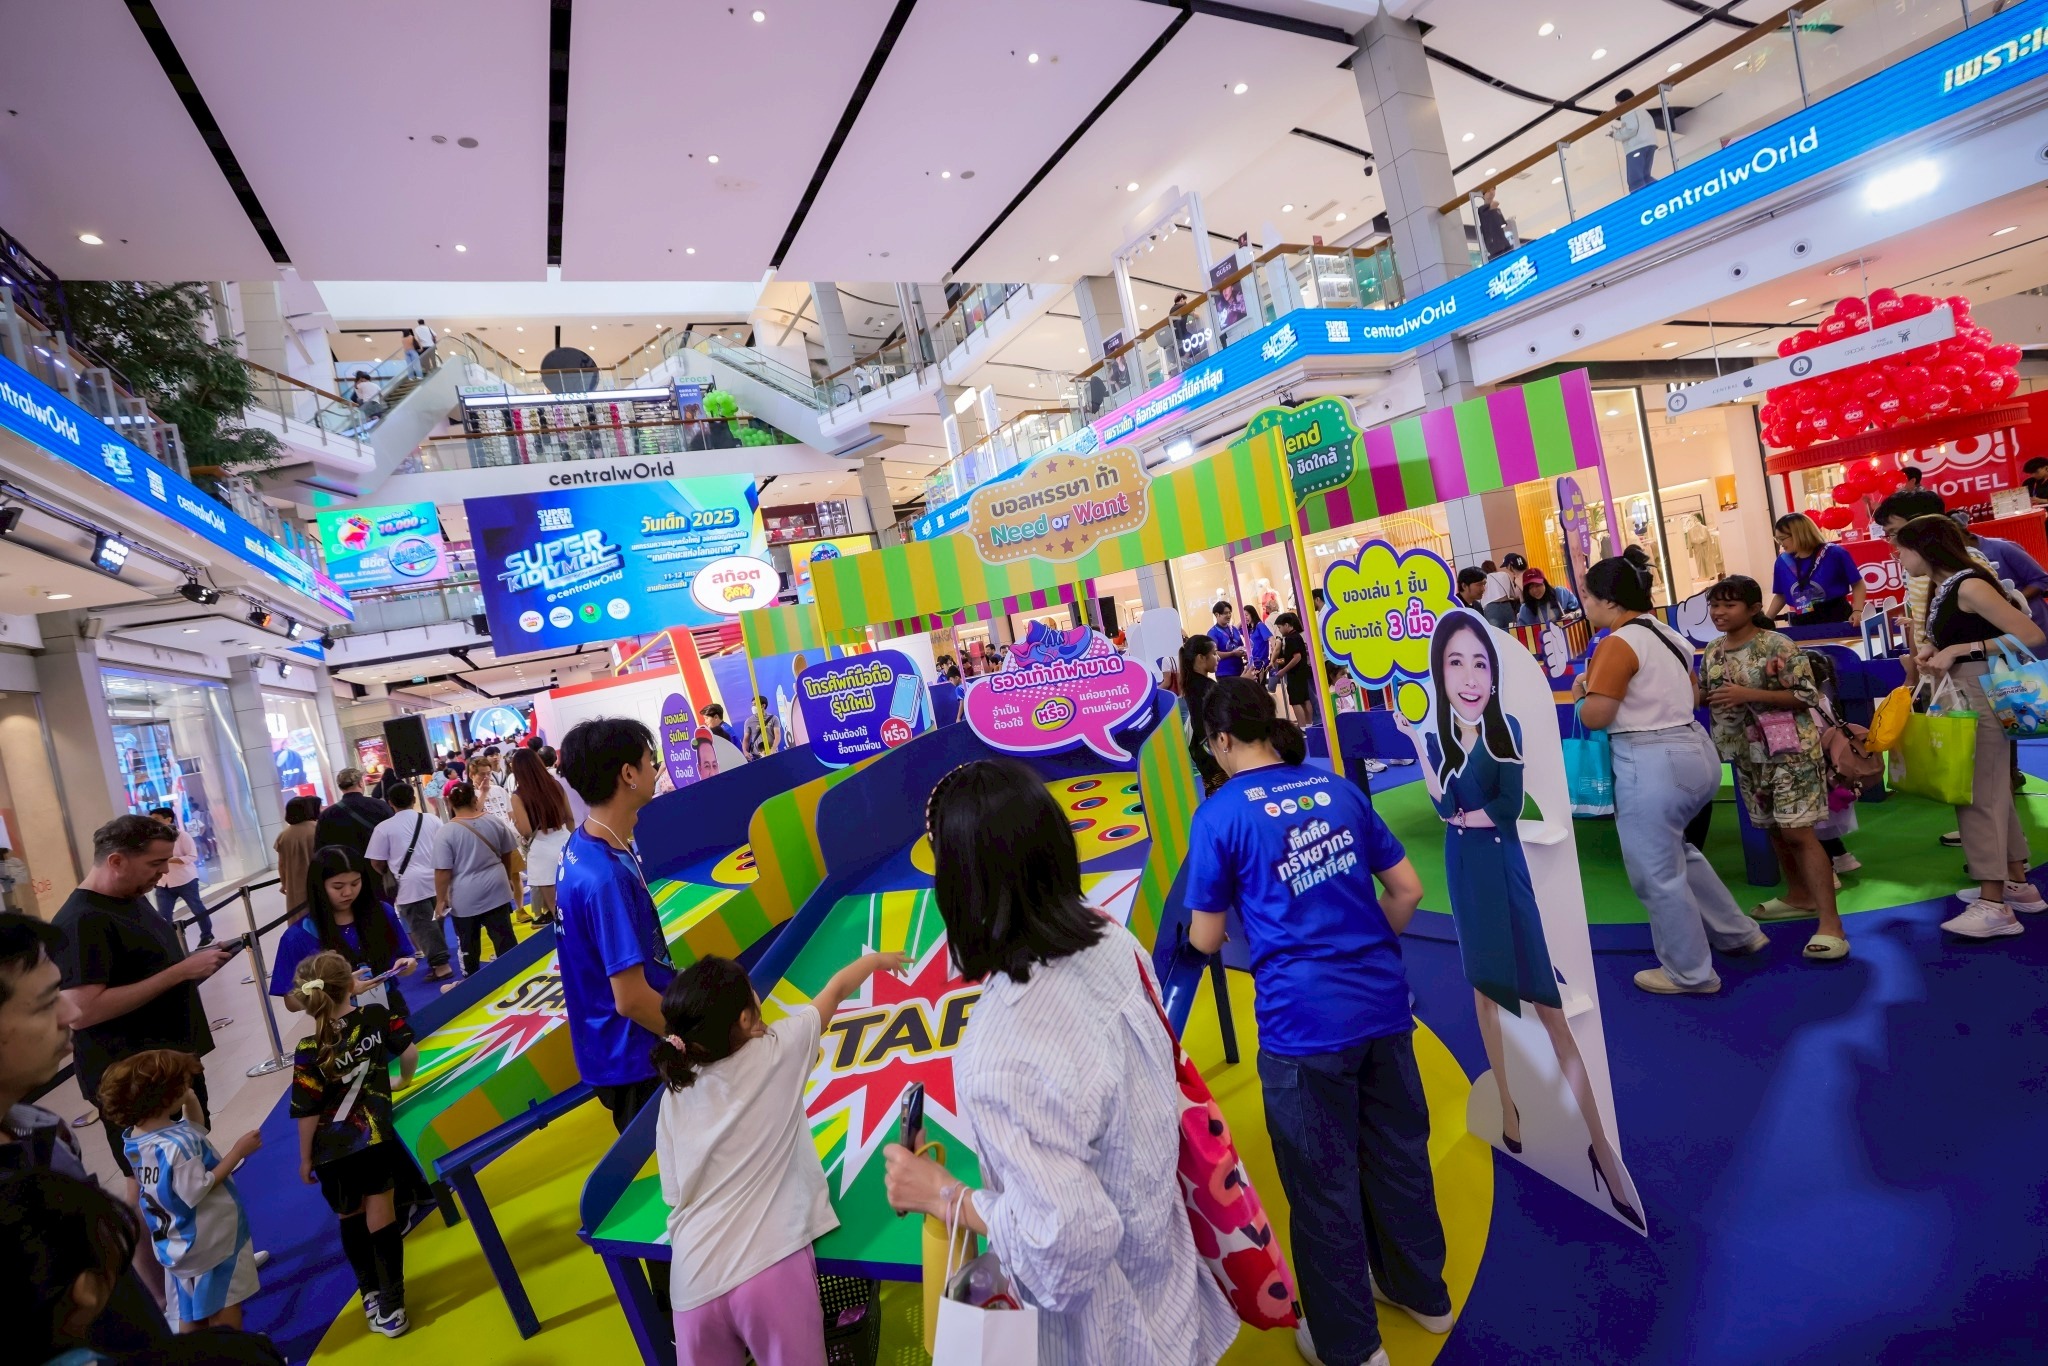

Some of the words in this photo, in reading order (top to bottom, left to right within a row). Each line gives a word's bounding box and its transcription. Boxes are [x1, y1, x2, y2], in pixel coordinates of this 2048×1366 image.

[1640, 126, 1820, 226] centralwOrld
[1567, 224, 1604, 247] SUPER
[1325, 320, 1348, 330] SUPER
[1363, 295, 1458, 339] centralwOrld
[1827, 321, 1846, 333] GO!
[464, 383, 499, 394] crocs
[679, 376, 708, 384] crocs
[1844, 410, 1864, 421] GO!
[1880, 399, 1900, 410] GO!
[1285, 422, 1321, 453] end
[549, 460, 675, 487] centralwOrld
[990, 475, 1089, 518] บอลหรรษา
[1096, 464, 1119, 490] ท้า
[537, 507, 571, 519] SUPER
[539, 514, 573, 527] JEEW
[641, 512, 686, 533] วันเด็ก
[692, 508, 735, 528] 2025
[990, 513, 1049, 545] Need
[1052, 512, 1071, 531] or
[1072, 492, 1130, 527] Want
[505, 529, 603, 576] SUPER
[547, 570, 623, 603] @centralwOrld
[663, 571, 683, 580] 11-12
[712, 569, 761, 585] สก๊อต
[1342, 580, 1390, 604] ของเล่น
[1395, 579, 1404, 596] 1
[1407, 570, 1428, 594] ชิ้น
[1858, 561, 1901, 593] O!
[1334, 621, 1383, 641] กินข้าวได้
[1388, 615, 1402, 637] 3
[1408, 601, 1435, 635] มื้อ
[805, 661, 892, 697] โทรศัพท์มือถือ
[992, 655, 1122, 692] รองเท้ากีฬาขาด
[832, 690, 874, 719] รุ่นใหม่
[1079, 684, 1131, 702] แค่อยากได้
[992, 705, 1021, 720] จำเป็น
[1036, 700, 1070, 724] หรือ
[1081, 698, 1132, 716] ตามเพื่อน?
[822, 725, 868, 743] จำเป็นต้องใช้
[883, 723, 910, 742] หรือ
[993, 715, 1024, 731] ต้องใช้
[837, 737, 882, 755] ซื้อตามเพื่อน
[1271, 775, 1330, 793] centralwOrld
[1288, 819, 1330, 851] เด็กคือ
[1277, 829, 1354, 882] ทรัพยากร
[1290, 851, 1358, 897] ที่มีค่าที่สุด
[495, 975, 567, 1010] STA
[815, 992, 985, 1070] TA
[332, 1058, 371, 1122] 7
